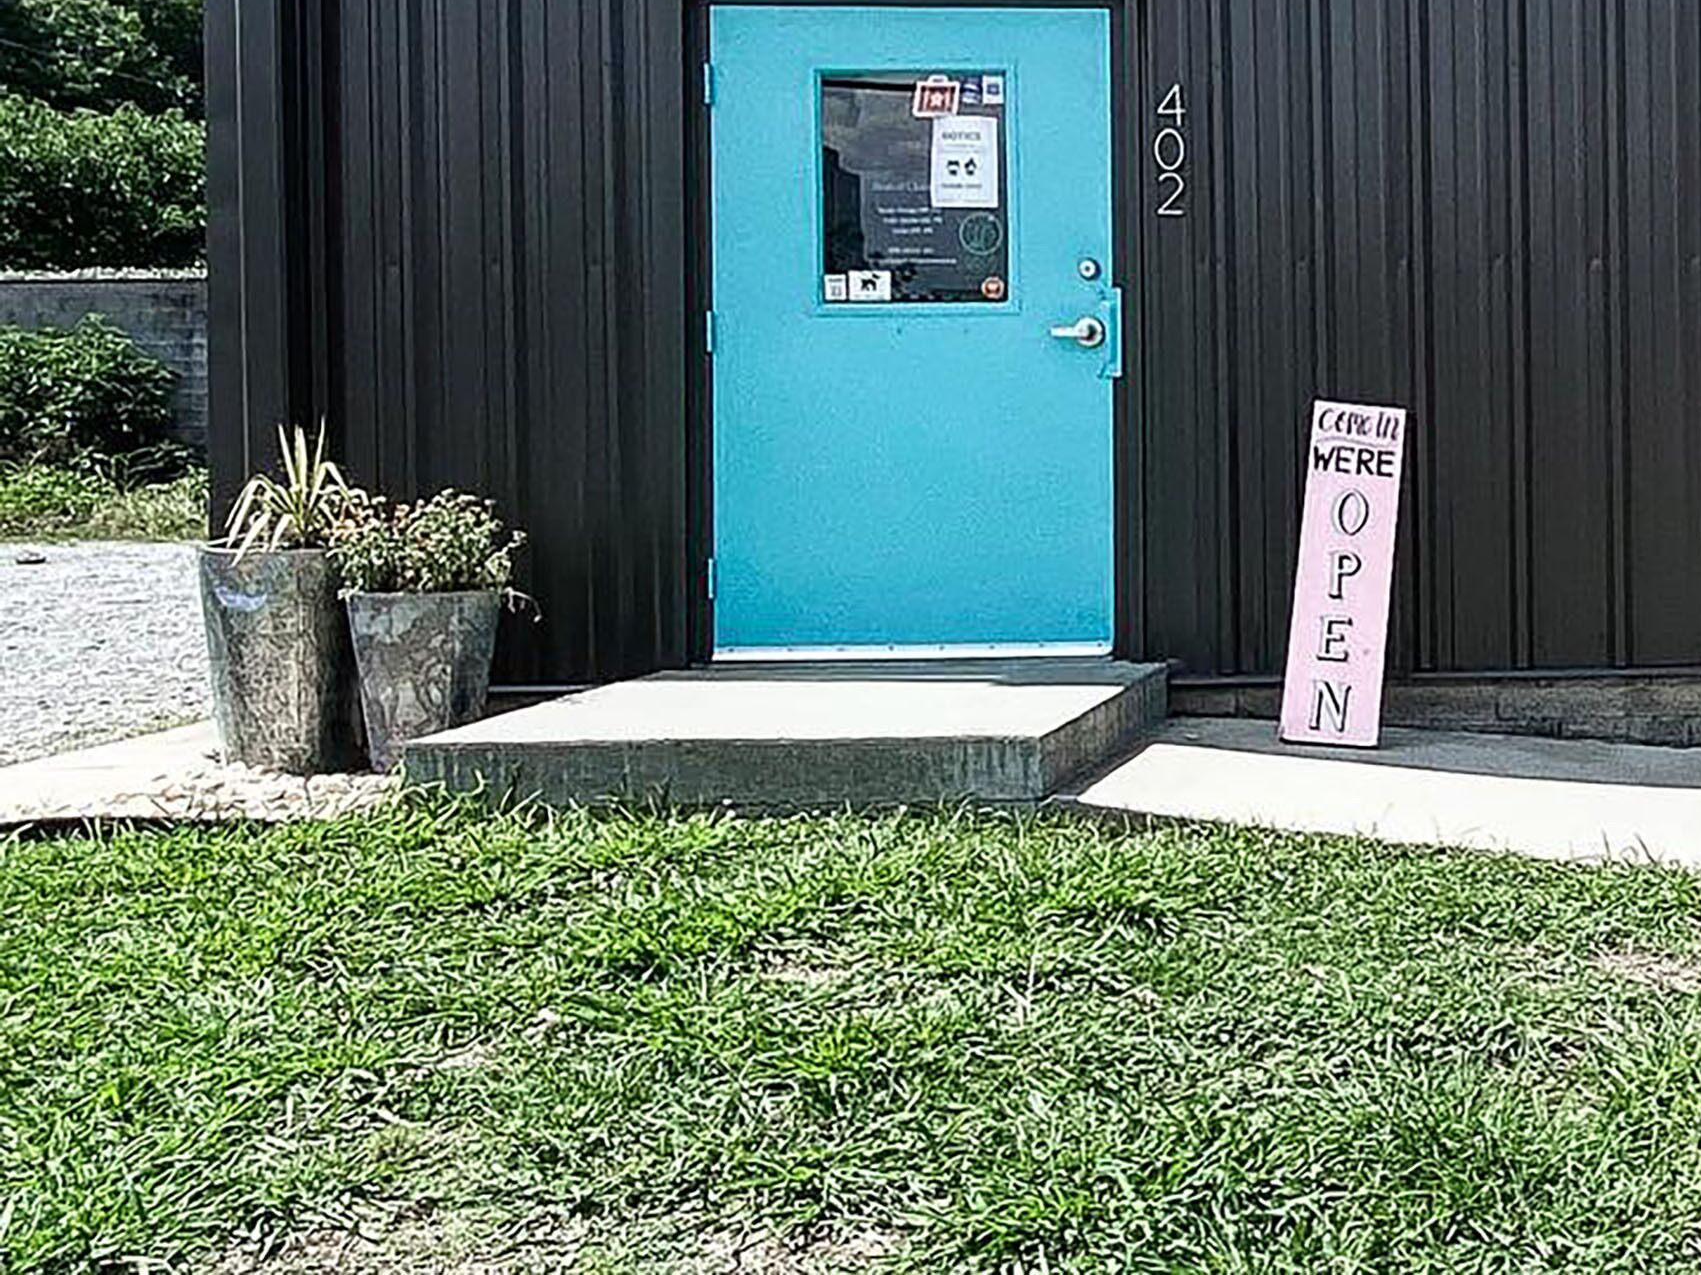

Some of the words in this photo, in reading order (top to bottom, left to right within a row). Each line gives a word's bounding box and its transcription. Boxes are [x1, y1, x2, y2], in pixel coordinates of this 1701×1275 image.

[1154, 83, 1186, 215] 402
[1313, 445, 1396, 478] WERE
[1308, 488, 1370, 733] OPEN
